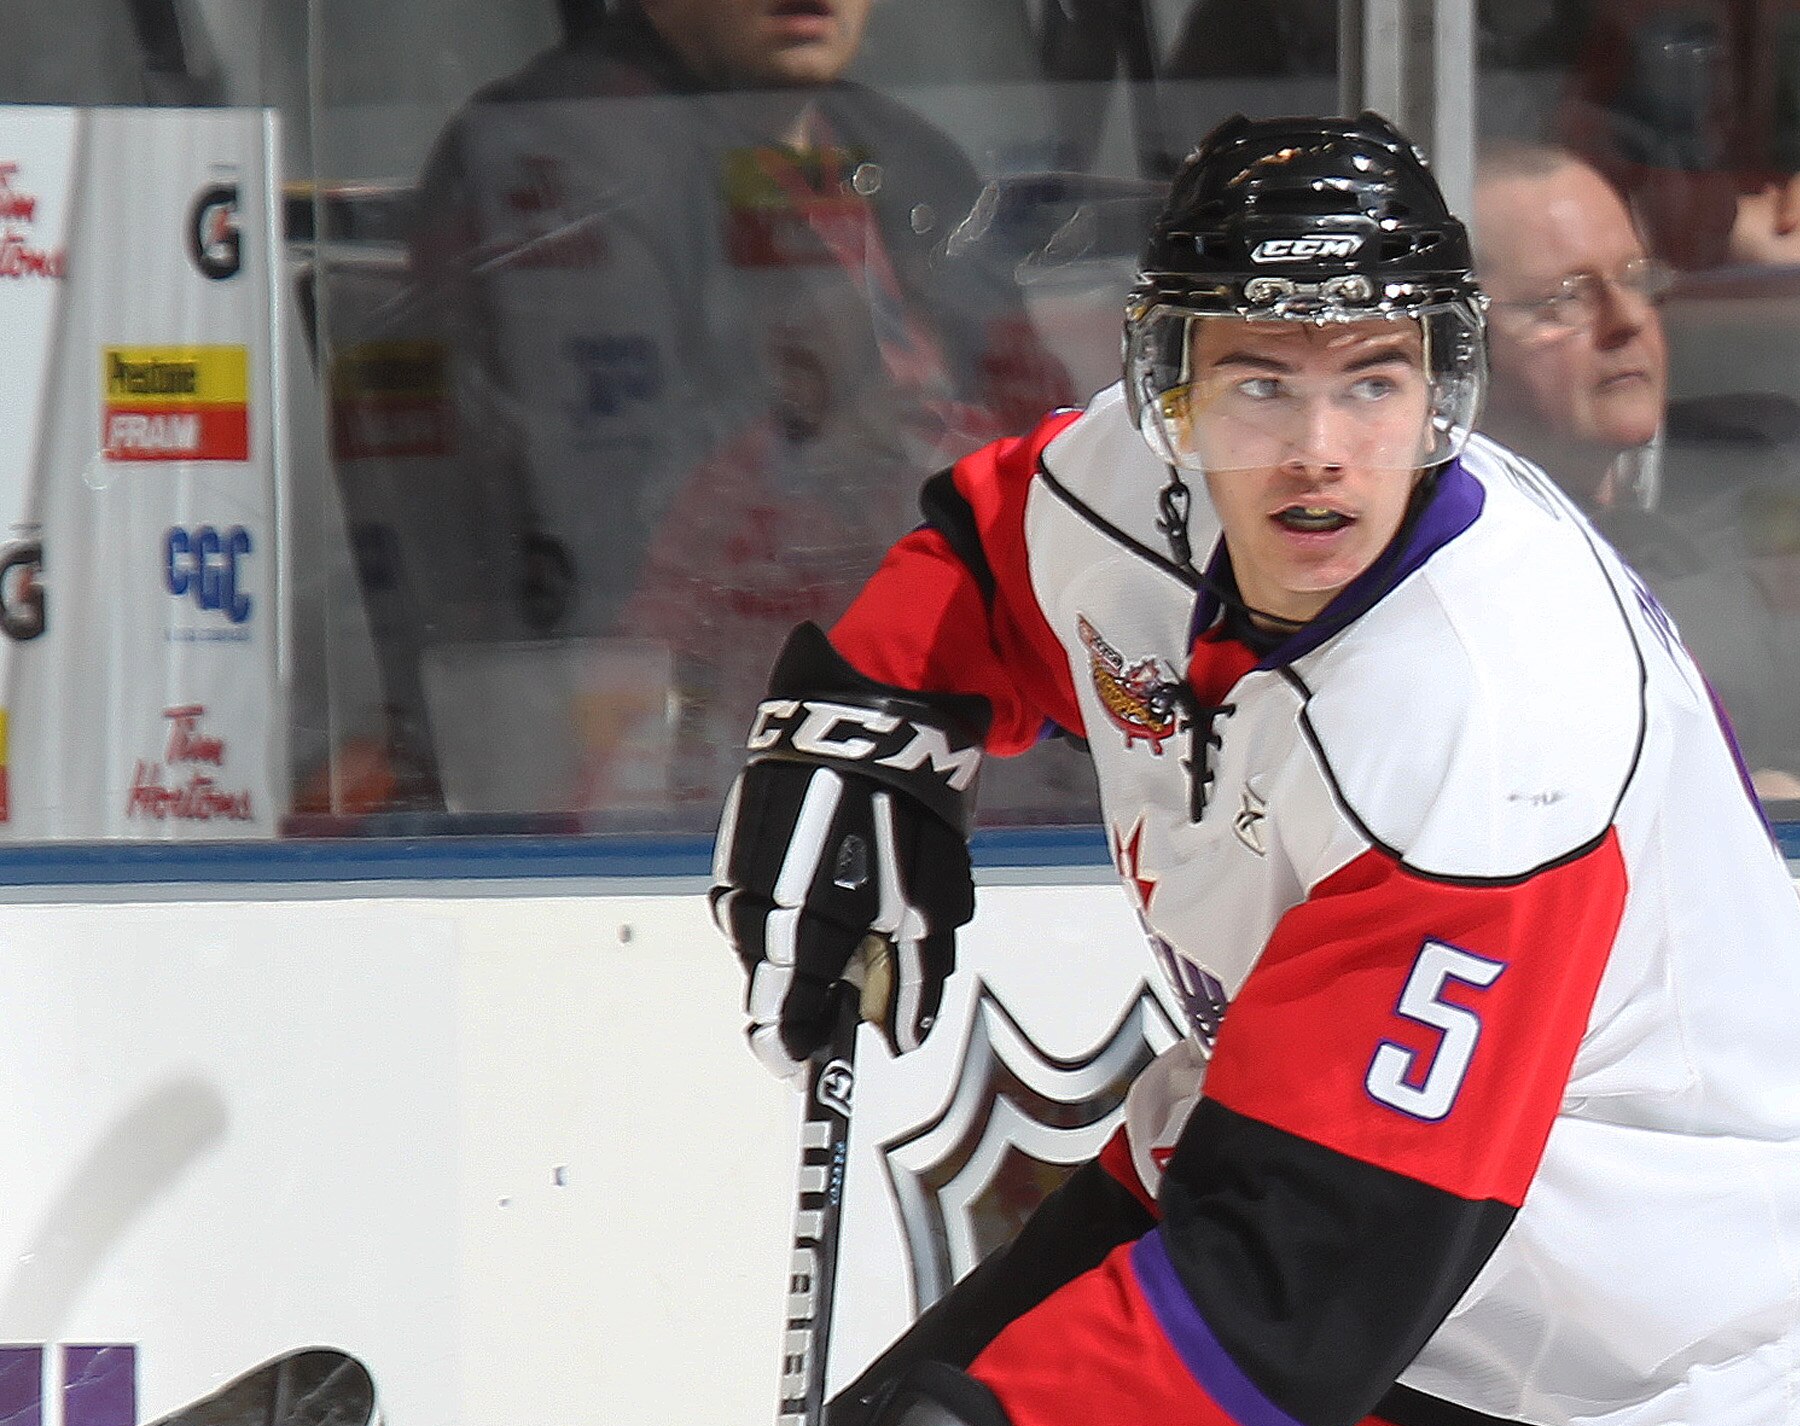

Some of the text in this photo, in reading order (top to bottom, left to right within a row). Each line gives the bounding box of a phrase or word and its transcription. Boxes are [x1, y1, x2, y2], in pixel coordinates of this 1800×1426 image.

[1257, 237, 1356, 262] CCM
[108, 411, 197, 451] FRAM
[163, 704, 225, 765] Tim
[746, 699, 984, 790] CCM
[127, 759, 252, 820] Hortons
[1364, 934, 1508, 1124] 5
